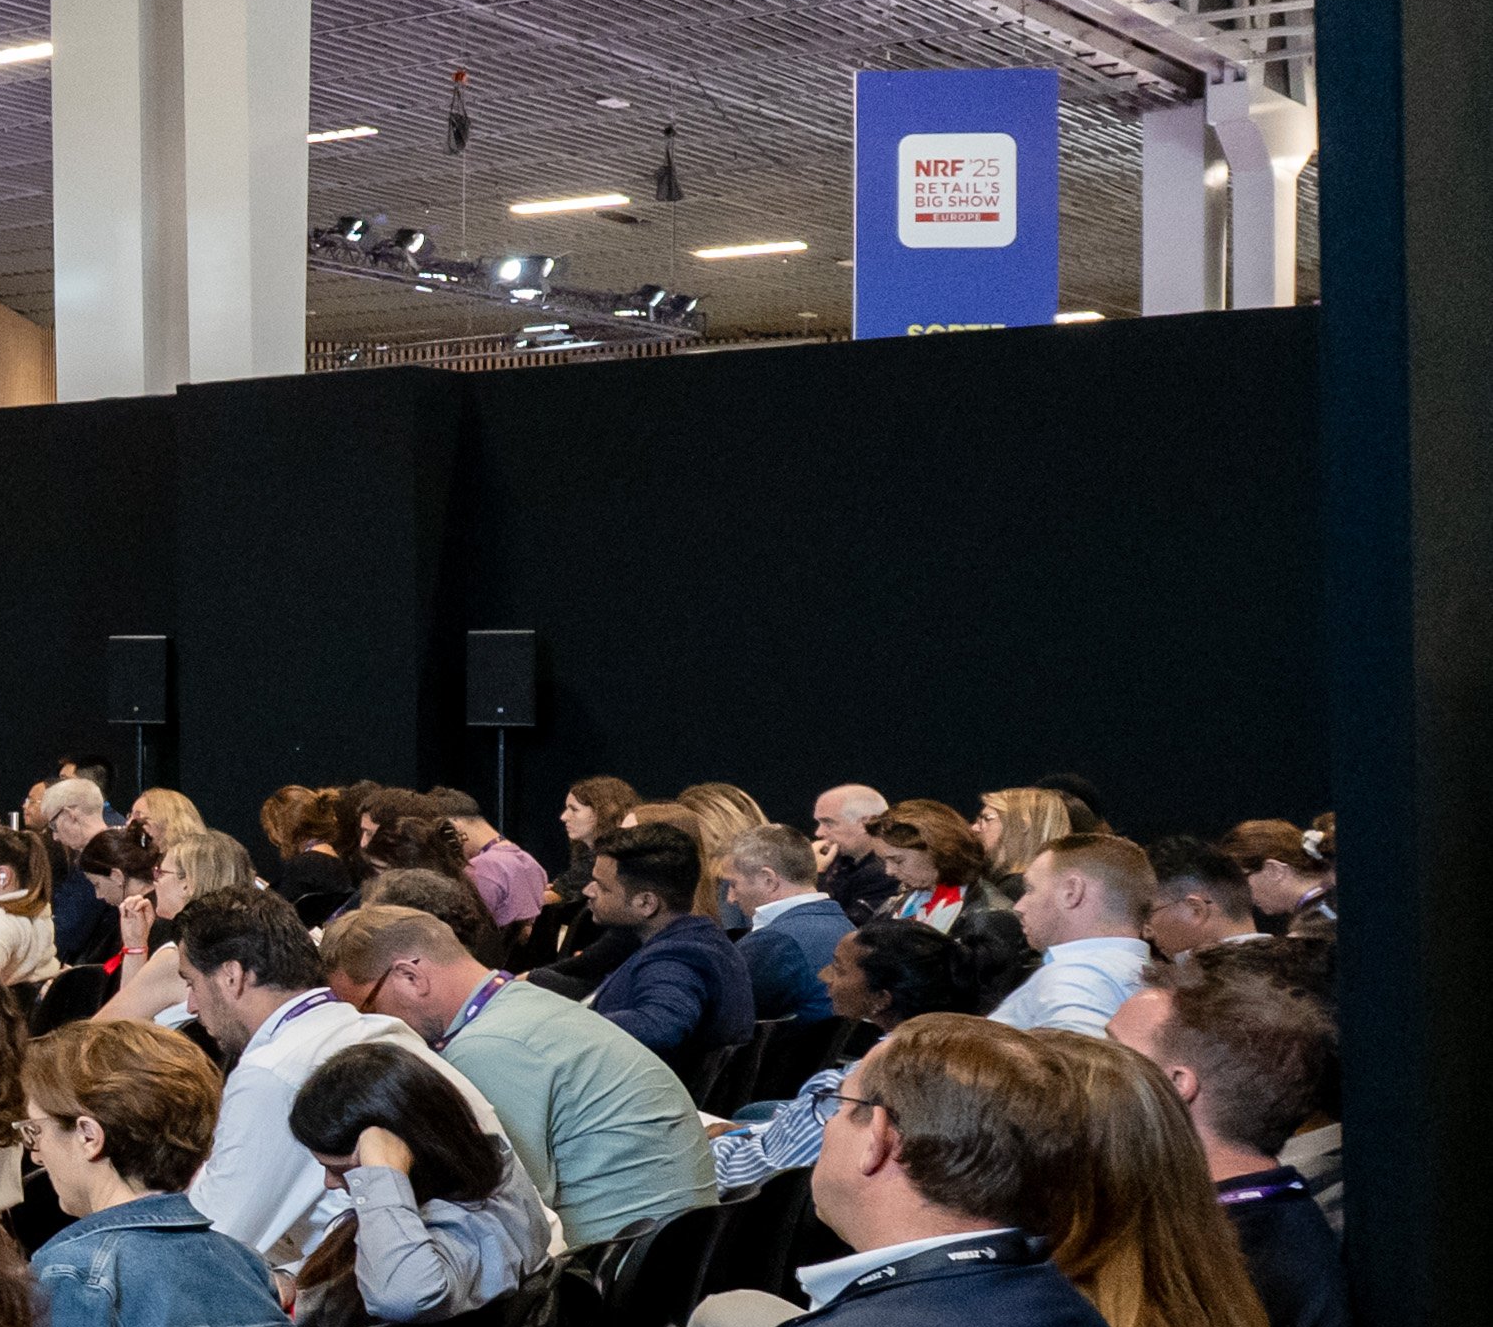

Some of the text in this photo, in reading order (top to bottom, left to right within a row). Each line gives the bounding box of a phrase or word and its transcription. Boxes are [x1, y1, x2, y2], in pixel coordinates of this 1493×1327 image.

[915, 158, 1000, 178] NRF '25
[915, 182, 1000, 194] RETAIL'S
[915, 195, 1000, 208] BIG SHOW
[933, 213, 981, 222] EUROPE
